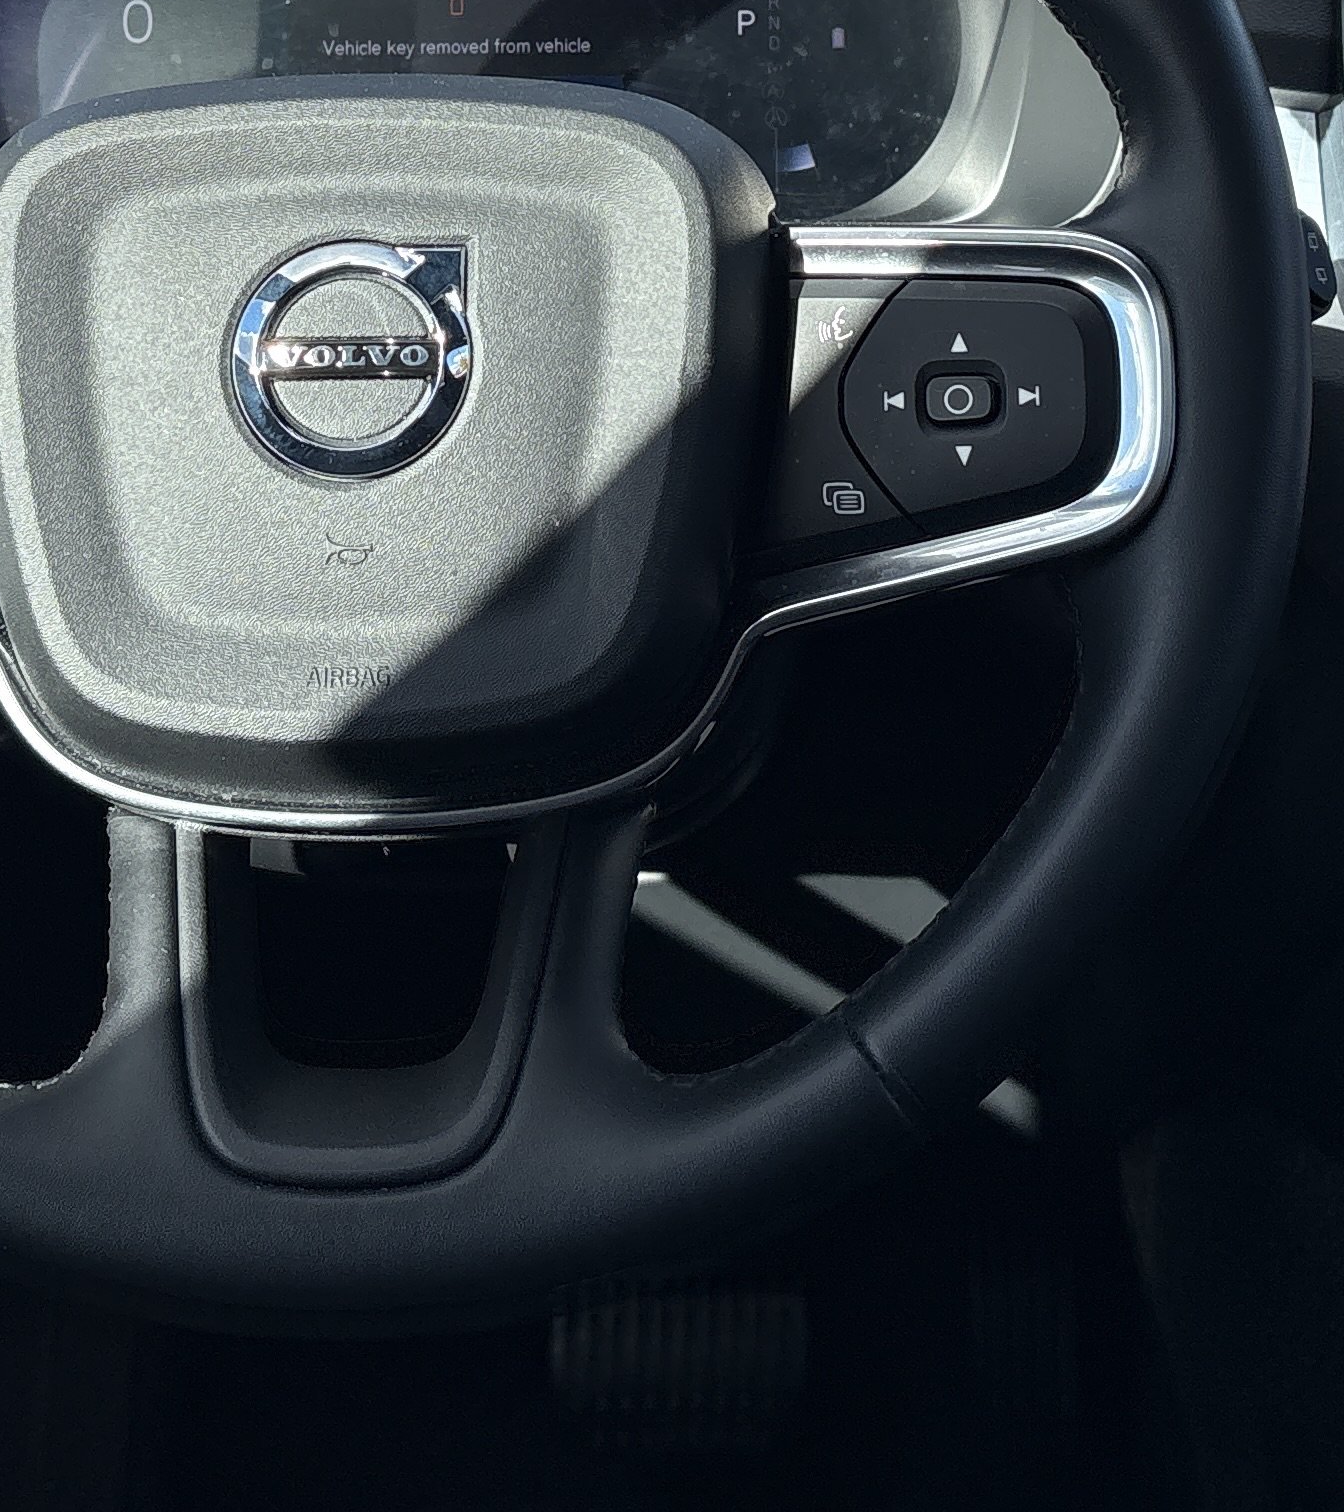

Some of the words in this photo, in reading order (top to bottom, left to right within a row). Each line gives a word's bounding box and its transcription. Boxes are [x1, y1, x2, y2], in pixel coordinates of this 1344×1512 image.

[123, 0, 153, 44] 0
[737, 9, 756, 36] P
[322, 40, 382, 56] Vehicle
[387, 40, 415, 59] key
[420, 38, 489, 55] removed
[495, 38, 530, 54] from
[536, 37, 591, 54] vehicle
[264, 344, 429, 368] VOLVO
[306, 665, 391, 688] AIRBAG
